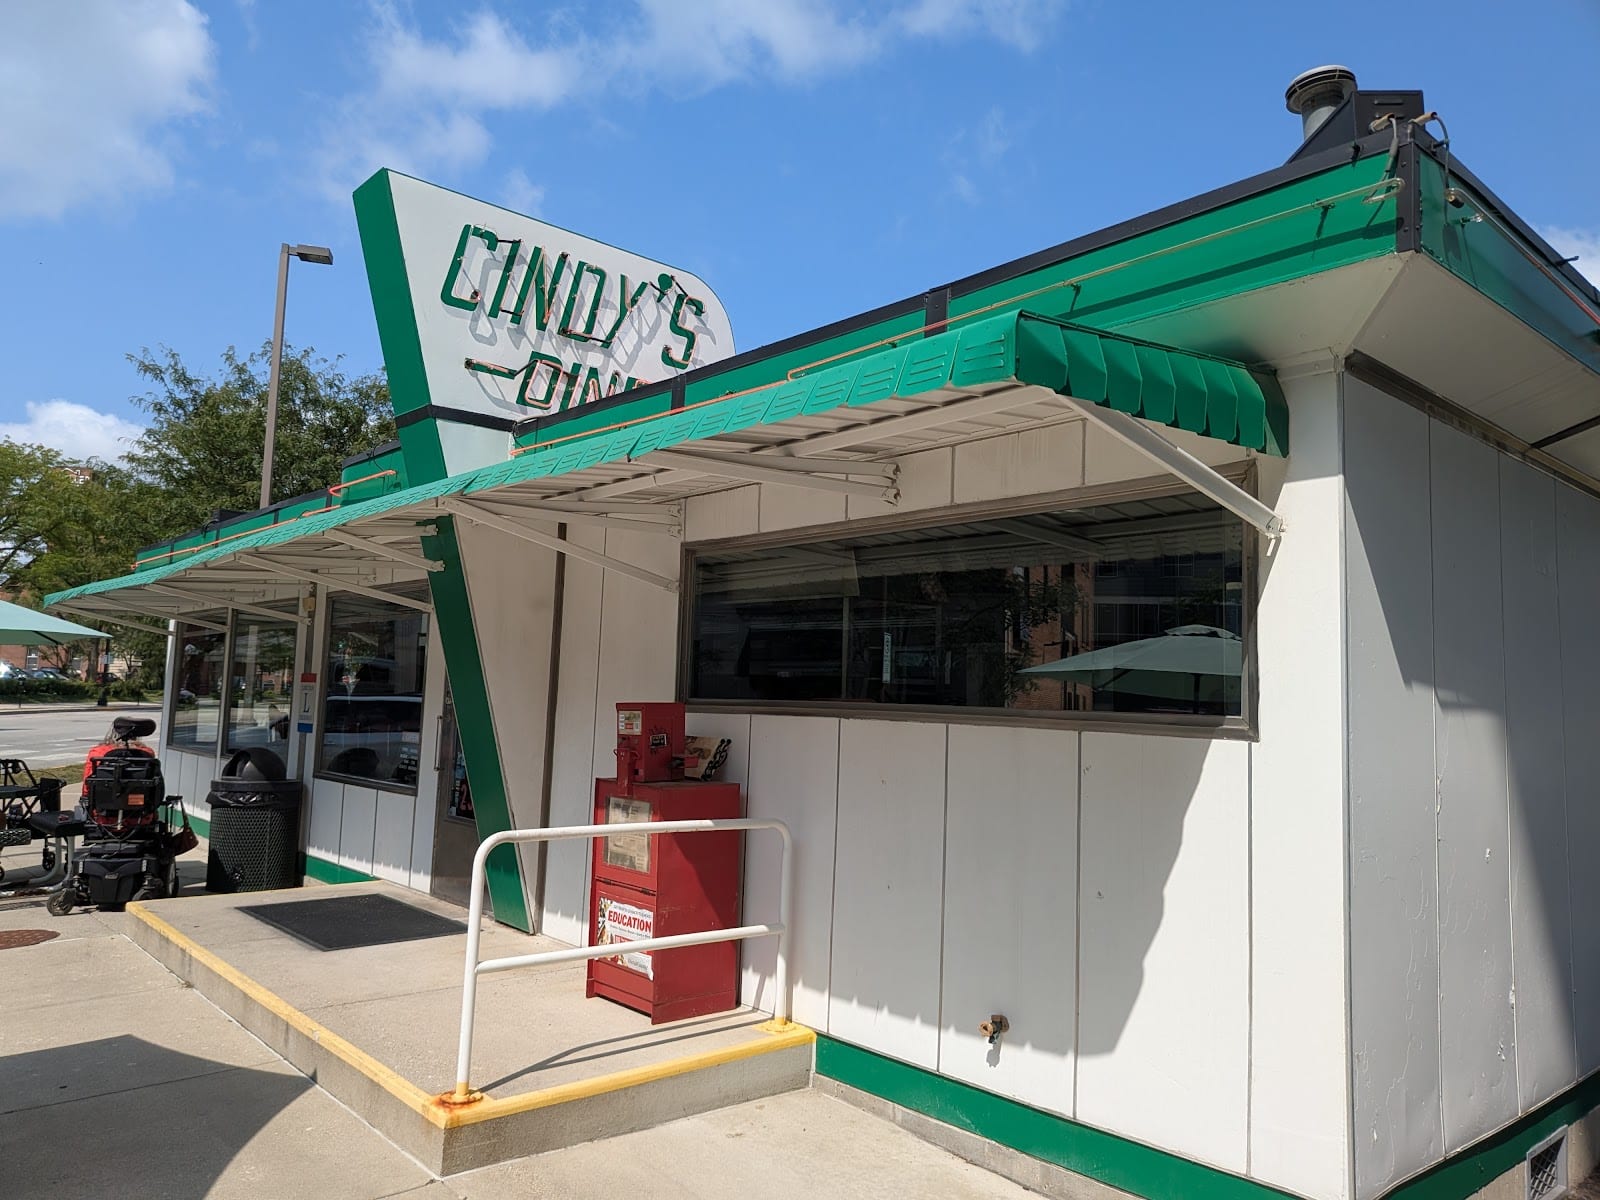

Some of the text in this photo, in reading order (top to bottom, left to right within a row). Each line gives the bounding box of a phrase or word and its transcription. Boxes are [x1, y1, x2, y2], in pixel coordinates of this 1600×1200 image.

[440, 224, 705, 369] CINDY'S
[516, 350, 652, 411] DIN
[608, 910, 652, 933] EDUCATION
